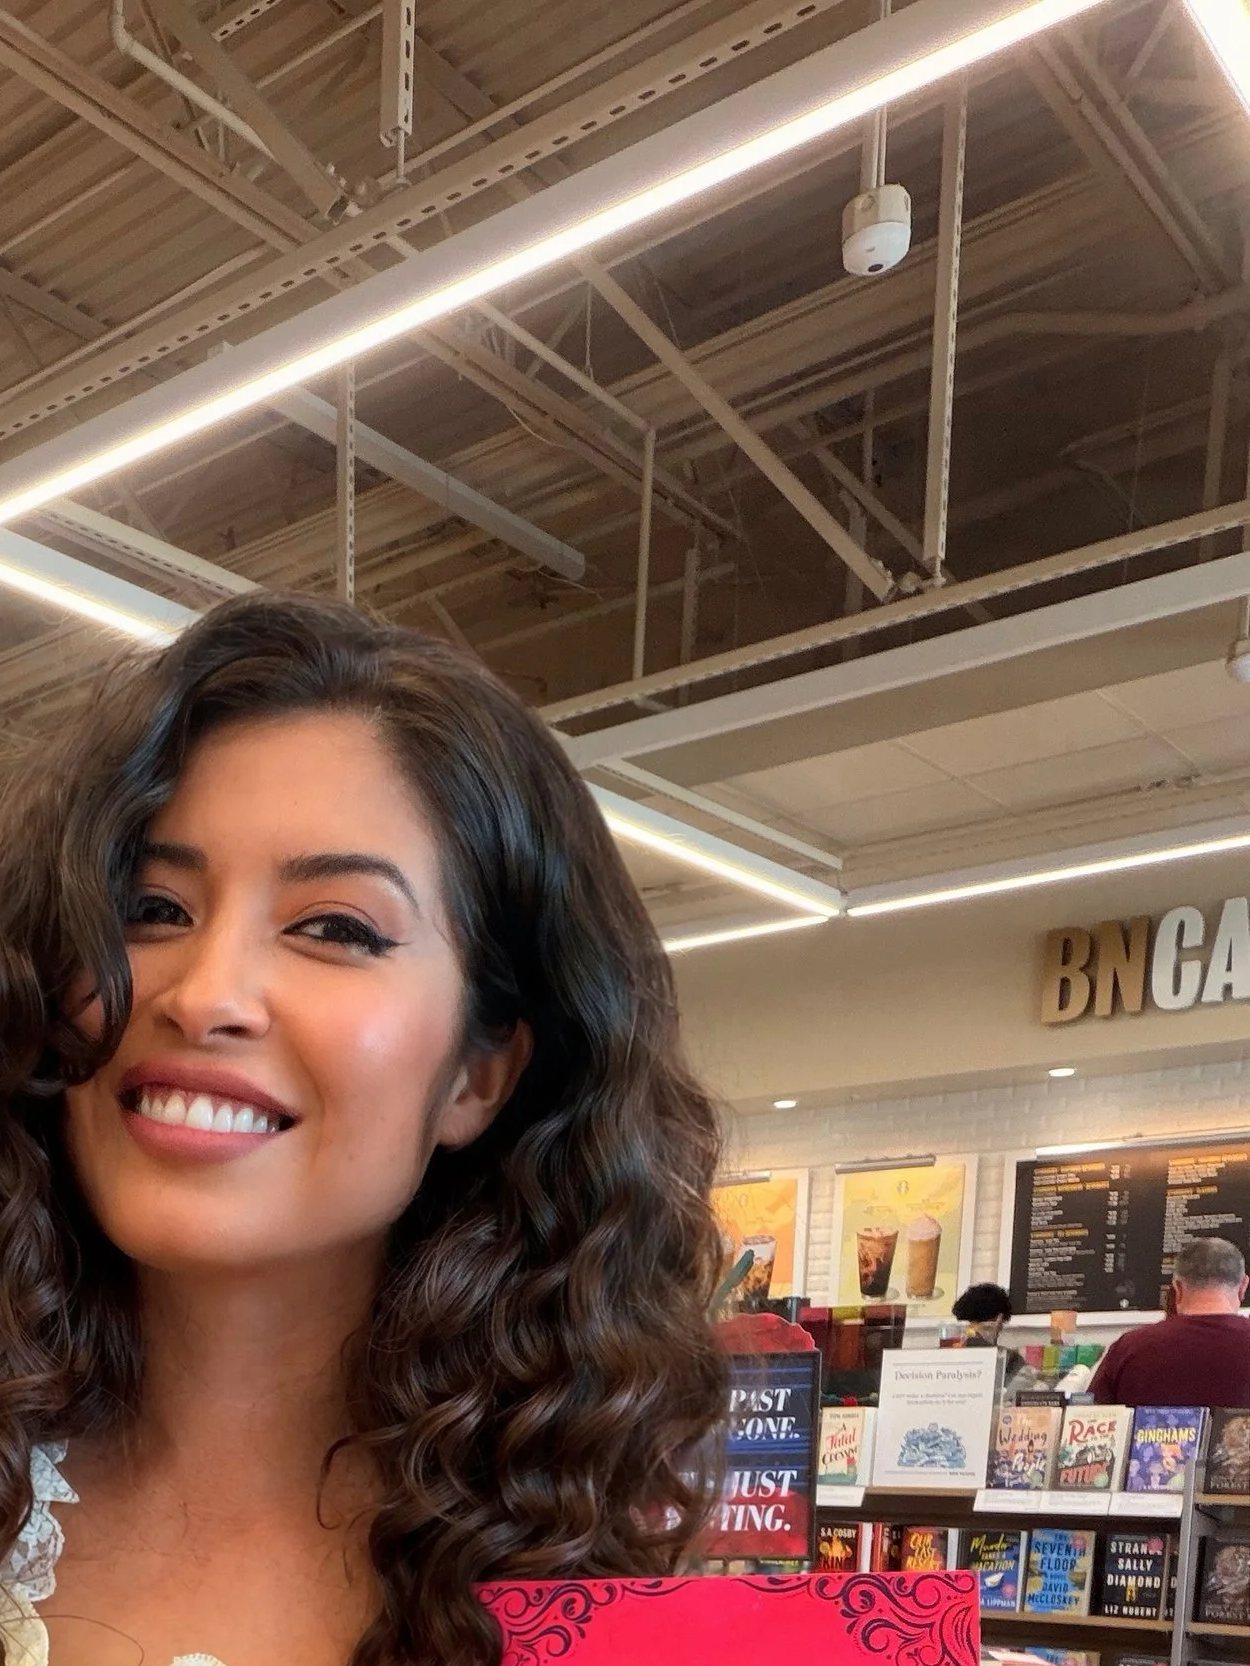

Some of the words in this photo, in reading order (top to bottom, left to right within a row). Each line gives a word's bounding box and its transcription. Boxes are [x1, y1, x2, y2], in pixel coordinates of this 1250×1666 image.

[895, 1370, 933, 1380] Decision
[936, 1370, 982, 1381] Paralysis?
[999, 1427, 1047, 1446] Wedding
[1068, 1419, 1117, 1444] RACE
[721, 1503, 791, 1532] TING.
[1034, 1542, 1087, 1557] SEVENTH
[1110, 1540, 1163, 1556] STRAN
[1040, 1557, 1077, 1571] FLOOR
[1117, 1557, 1153, 1572] SALLY
[1042, 1582, 1068, 1593] DAVID
[1106, 1574, 1161, 1589] DIAMOND
[987, 1598, 1016, 1608] LIPPMAN
[1104, 1604, 1119, 1615] LIZ
[1122, 1605, 1157, 1617] NUGENT
